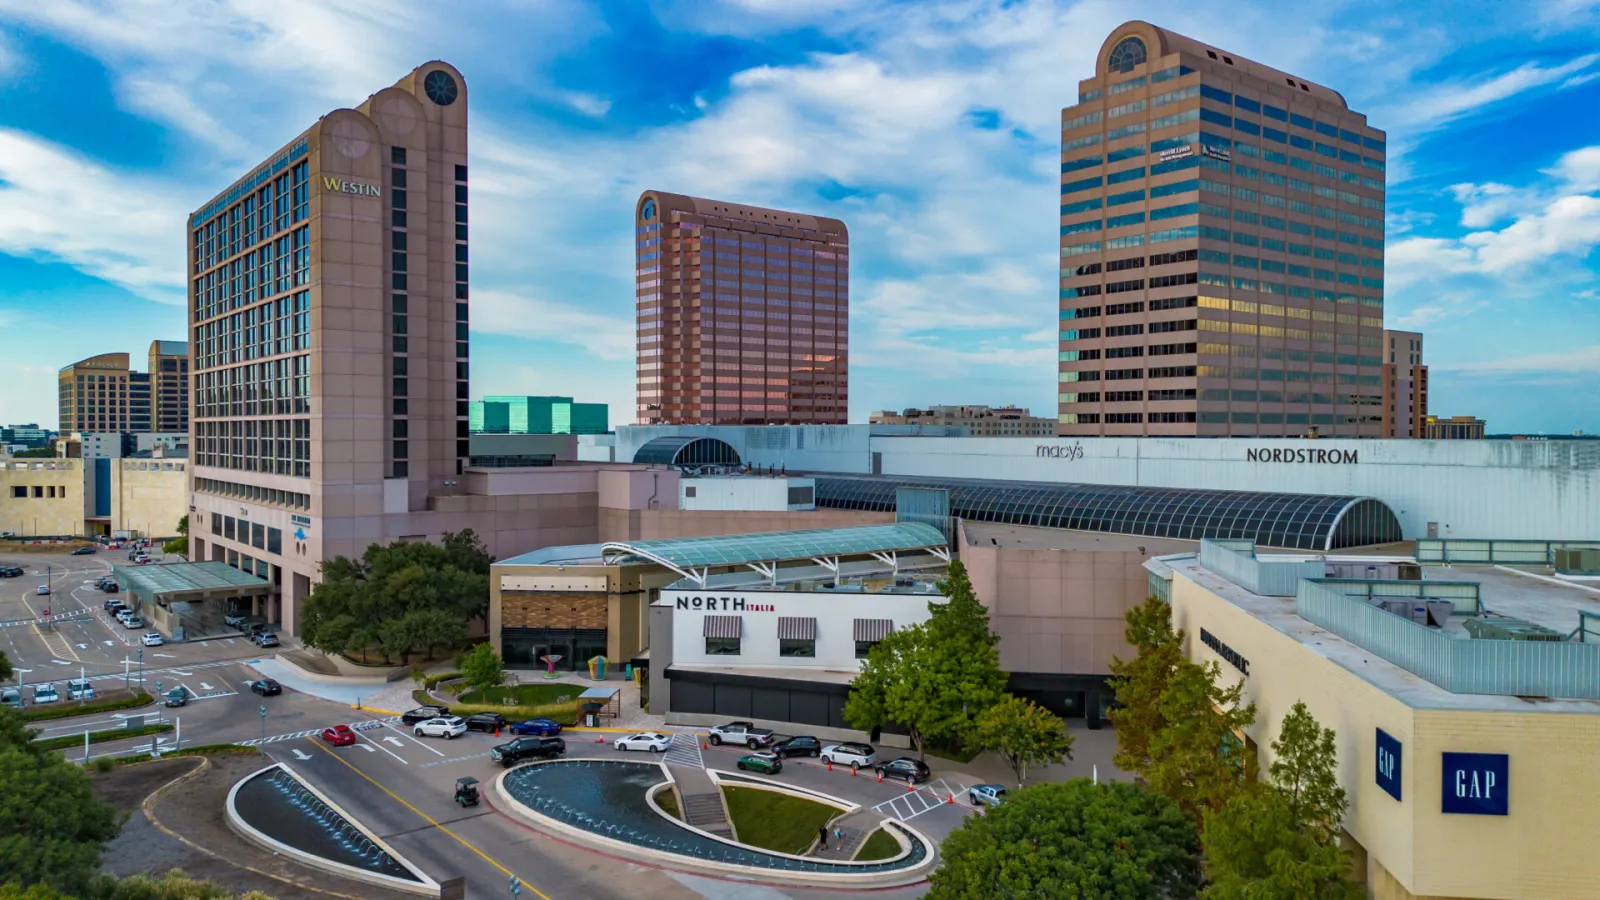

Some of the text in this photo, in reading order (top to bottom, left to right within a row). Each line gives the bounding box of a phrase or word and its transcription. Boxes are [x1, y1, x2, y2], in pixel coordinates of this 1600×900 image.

[1036, 440, 1084, 461] macy's
[1247, 448, 1358, 464] NORDSTROM
[676, 596, 775, 612] NORTH ITALIA
[1378, 746, 1395, 781] GAP
[1456, 769, 1496, 799] GAP
